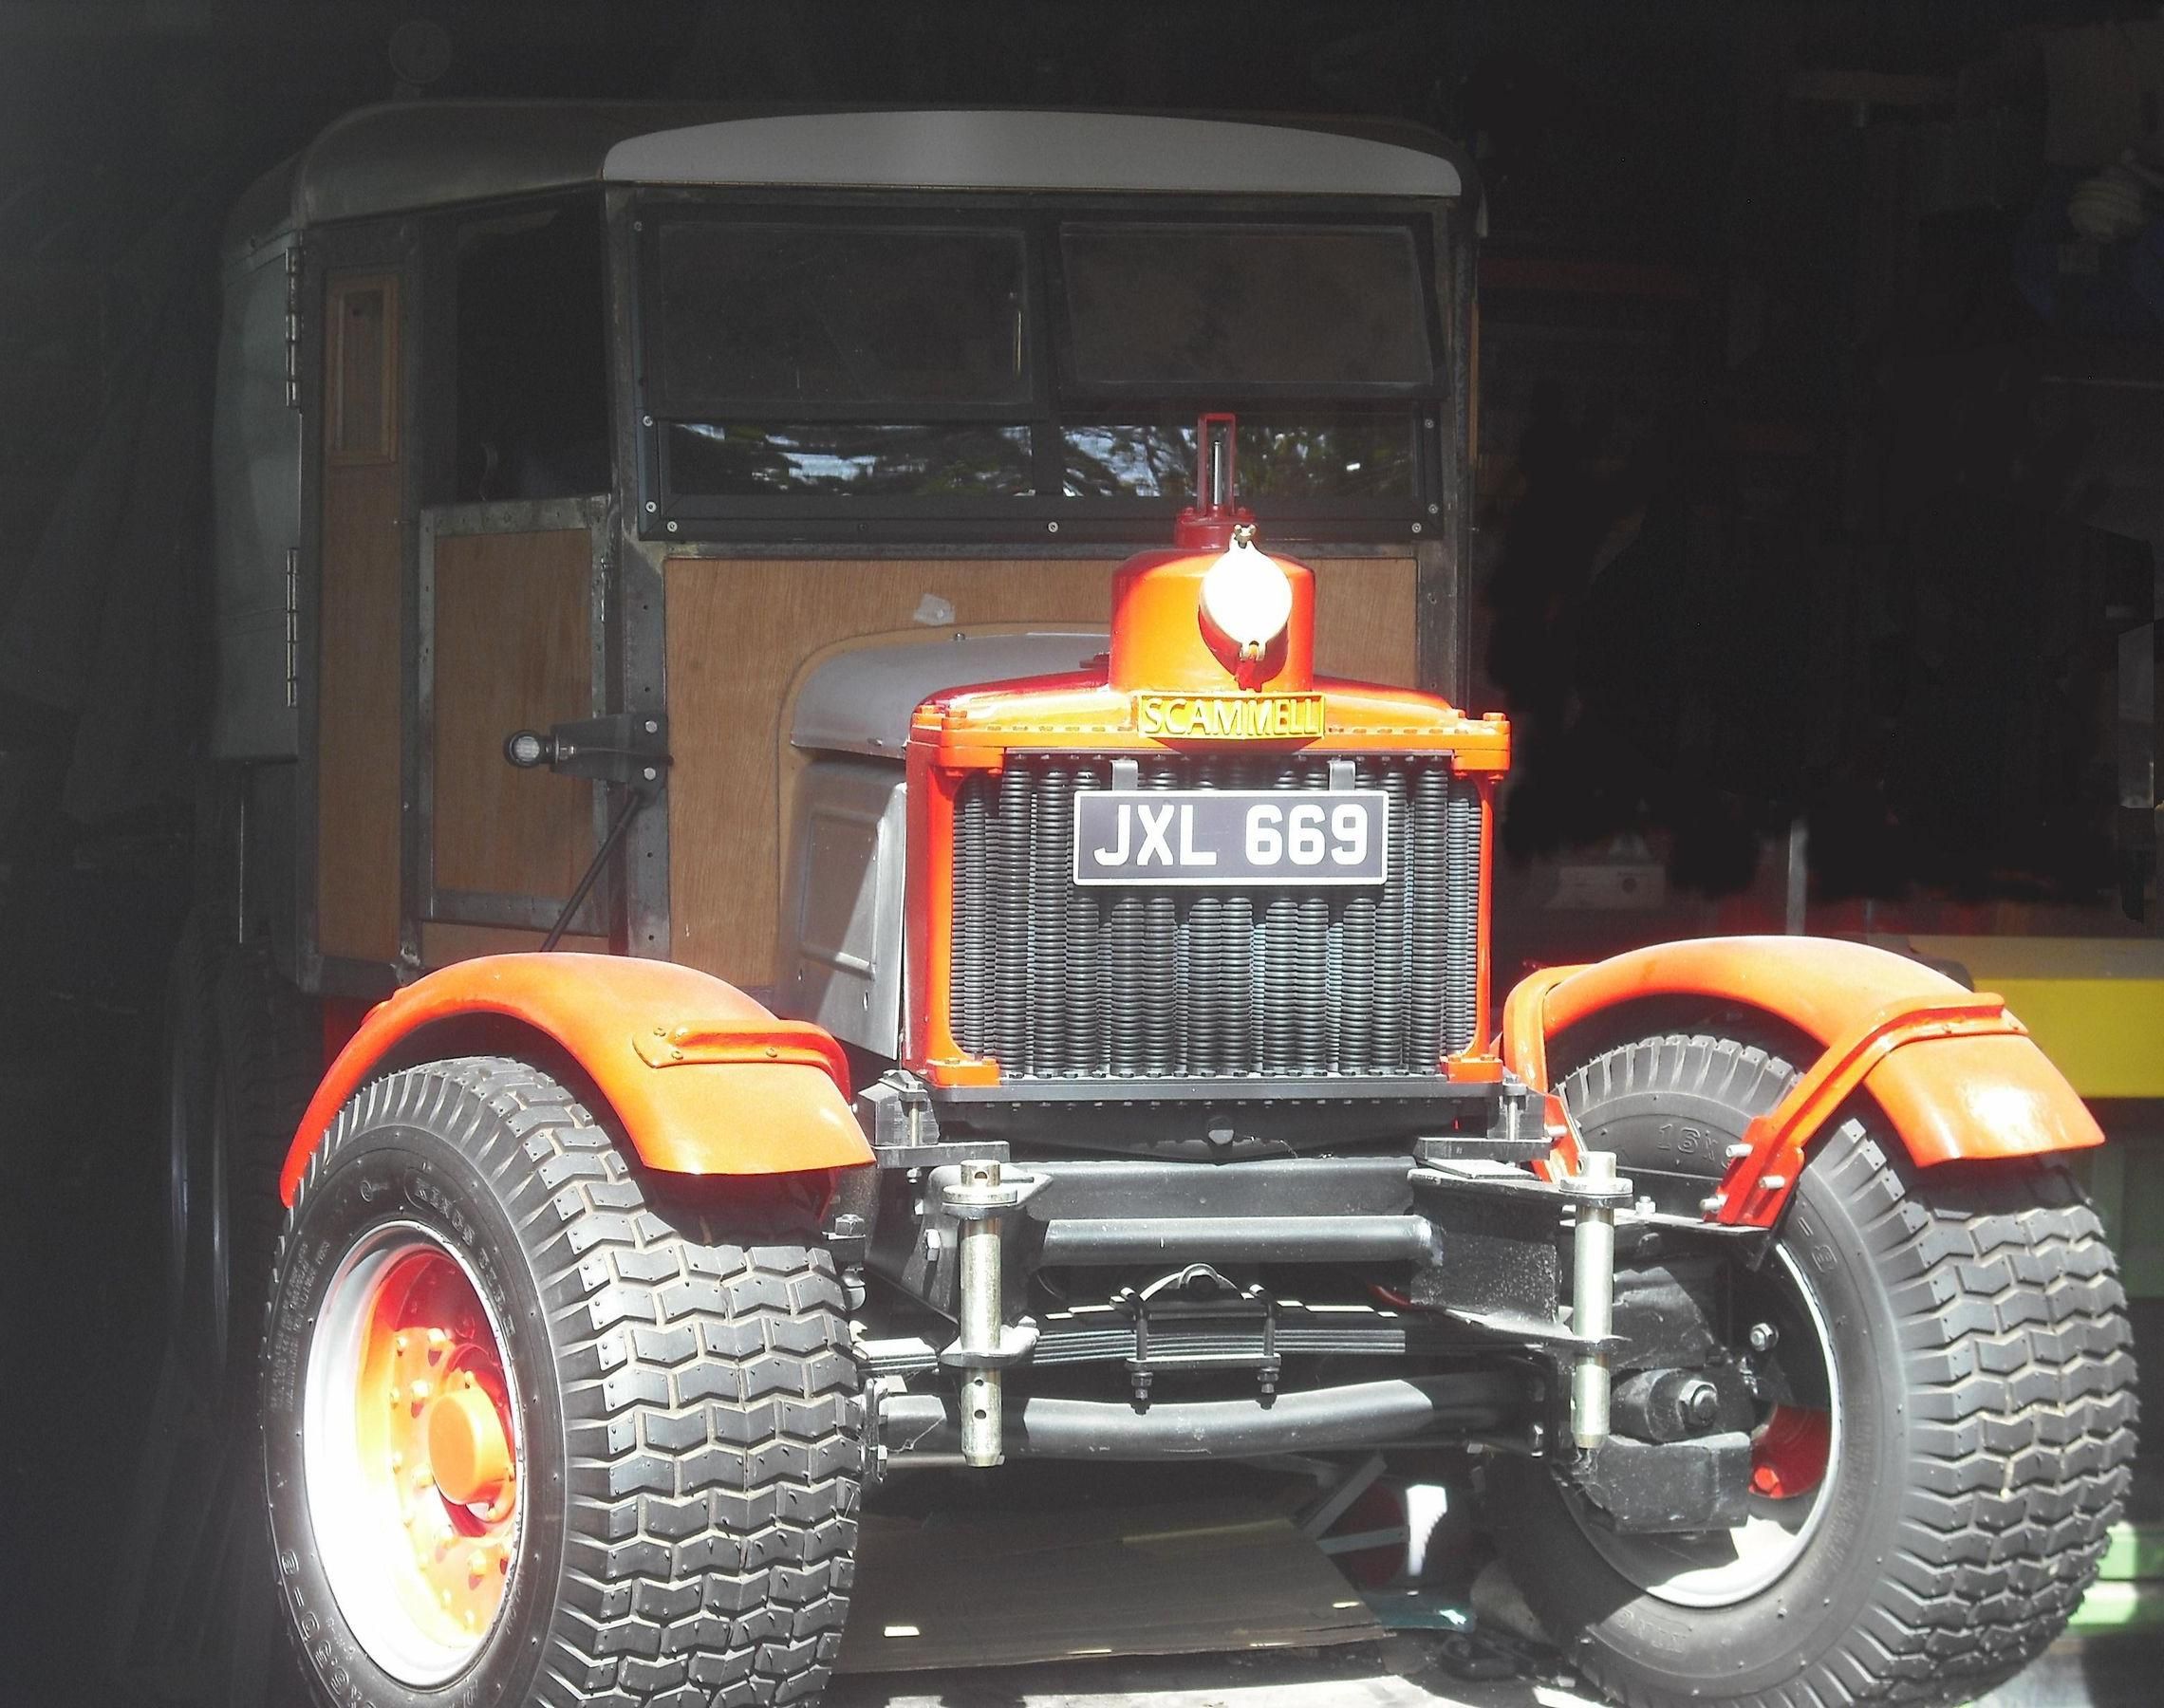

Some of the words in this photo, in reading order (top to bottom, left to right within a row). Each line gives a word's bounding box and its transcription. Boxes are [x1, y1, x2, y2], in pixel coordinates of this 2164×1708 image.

[1143, 696, 1319, 736] SCAMMELL
[1092, 804, 1217, 866] JXL
[1245, 803, 1369, 866] 669
